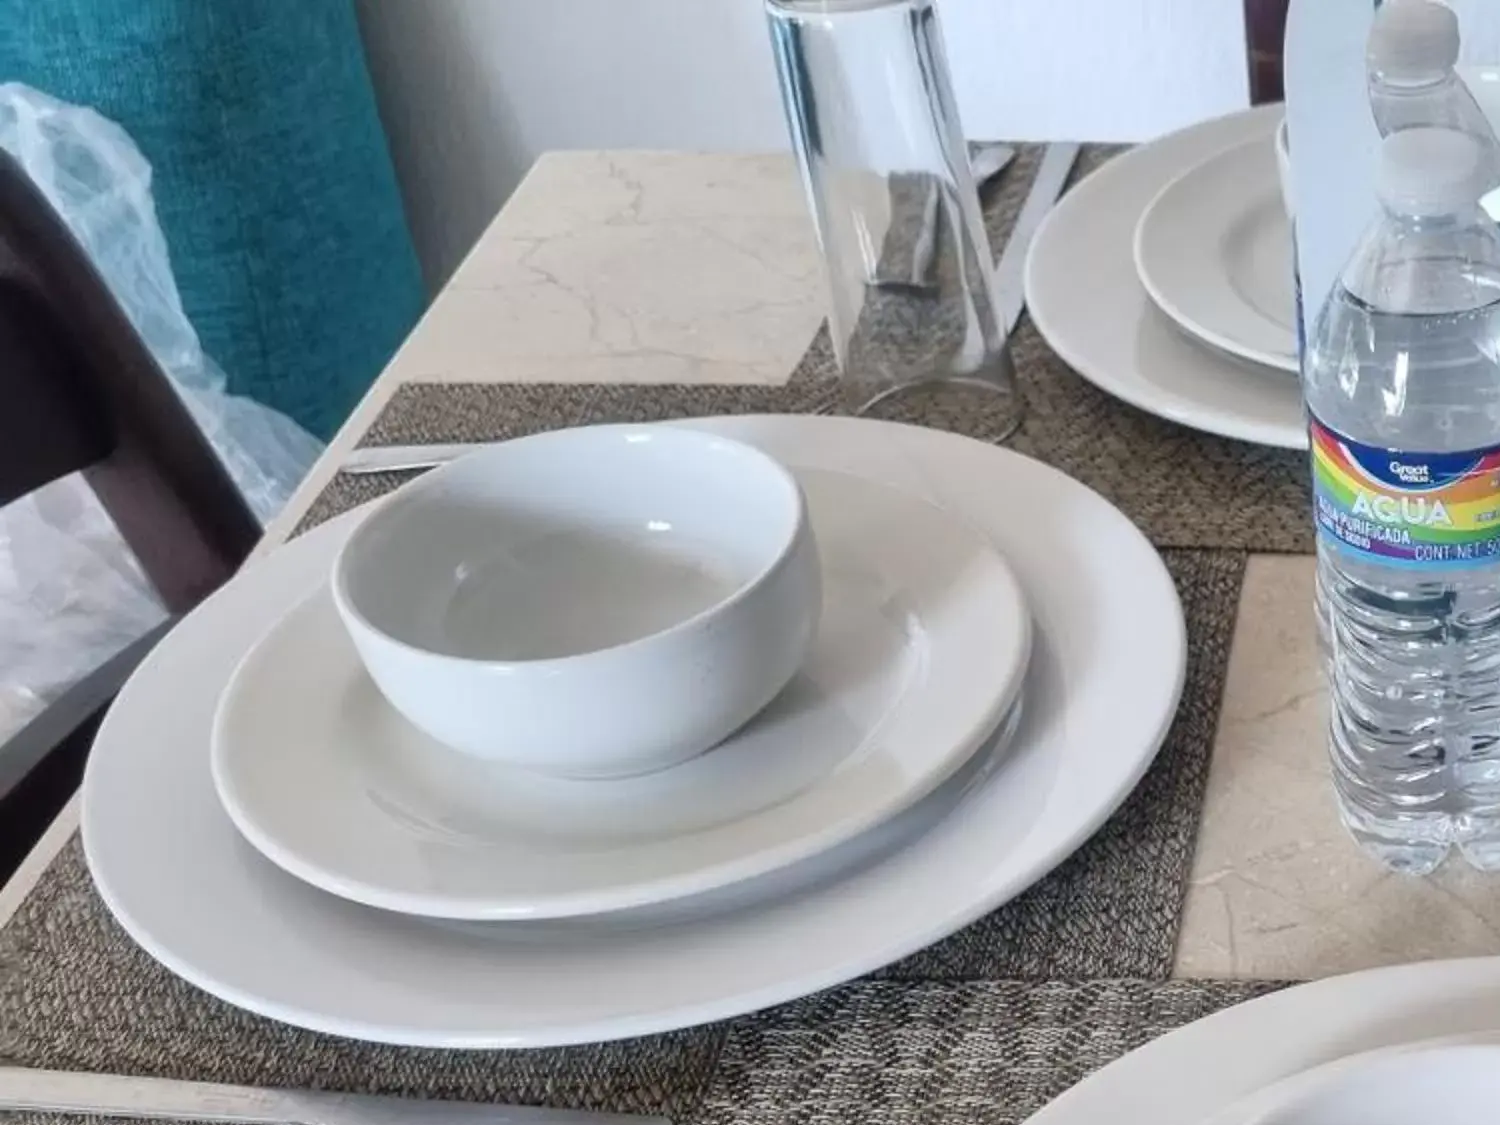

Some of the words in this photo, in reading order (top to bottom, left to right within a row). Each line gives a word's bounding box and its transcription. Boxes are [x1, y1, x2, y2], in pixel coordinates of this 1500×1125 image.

[1389, 461, 1429, 476] Great
[1351, 490, 1454, 528] AGUA
[1339, 511, 1411, 546] PURIFICADA
